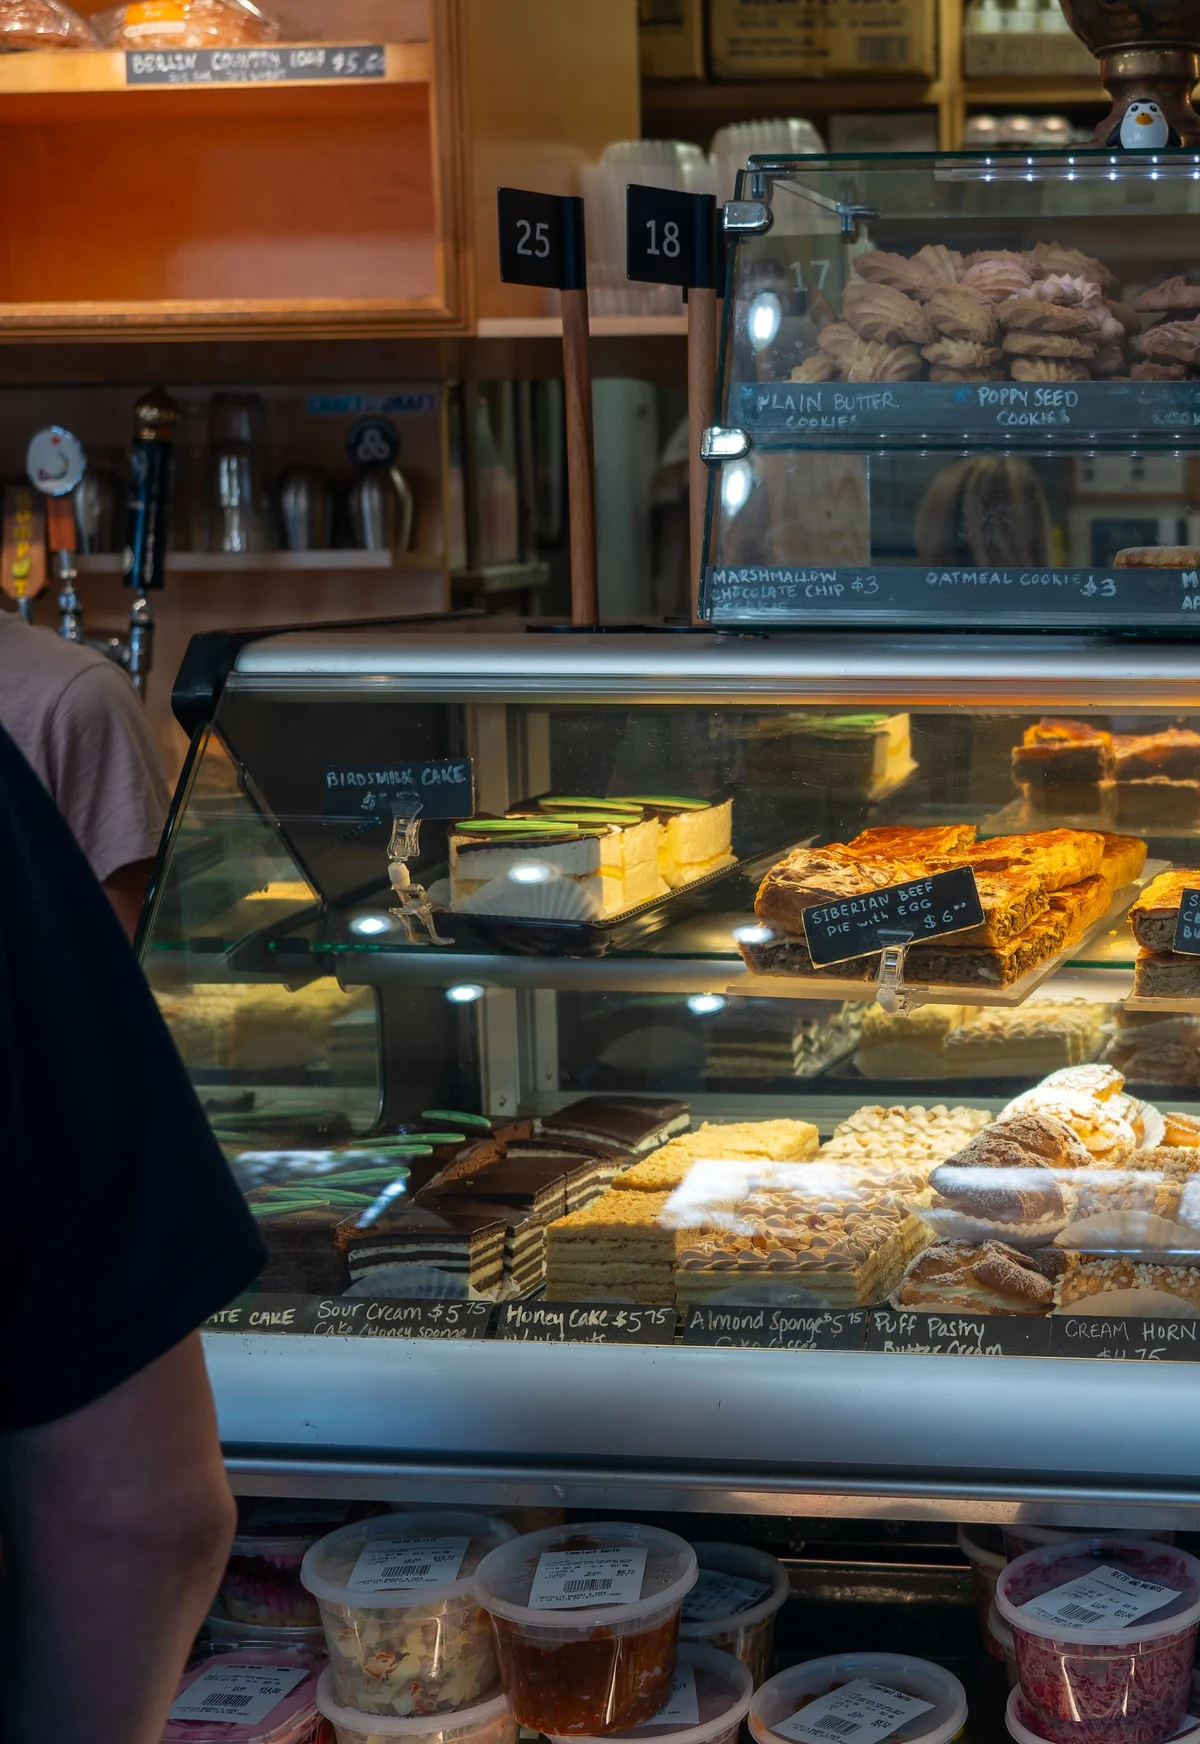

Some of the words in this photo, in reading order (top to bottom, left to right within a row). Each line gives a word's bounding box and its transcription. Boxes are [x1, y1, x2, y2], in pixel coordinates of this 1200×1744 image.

[516, 219, 550, 258] 25
[645, 219, 681, 258] 18
[834, 390, 900, 411] BUTTER
[978, 386, 1028, 407] POPPY
[1034, 386, 1079, 407] SEED
[713, 570, 837, 586] MARSHMALLOW
[925, 570, 1013, 587] OATMEAL
[1019, 572, 1081, 587] COOKIE
[1079, 574, 1117, 598] $3
[804, 584, 846, 598] CHIP
[421, 764, 467, 786] CAKE
[811, 893, 889, 925] SIBERIAN
[898, 881, 935, 902] BEEF
[826, 922, 850, 938] PIE
[856, 911, 889, 929] with
[897, 899, 932, 916] EGG
[249, 1307, 297, 1327] CAKE
[316, 1300, 365, 1320] Sour
[366, 1302, 422, 1322] Cream
[506, 1304, 565, 1337] Honey
[689, 1308, 765, 1331] Almond
[769, 1310, 821, 1343] Sponge
[873, 1311, 918, 1336] Puff
[927, 1316, 986, 1347] Pastry
[1065, 1319, 1130, 1342] CREAM
[1142, 1321, 1197, 1342] HORN
